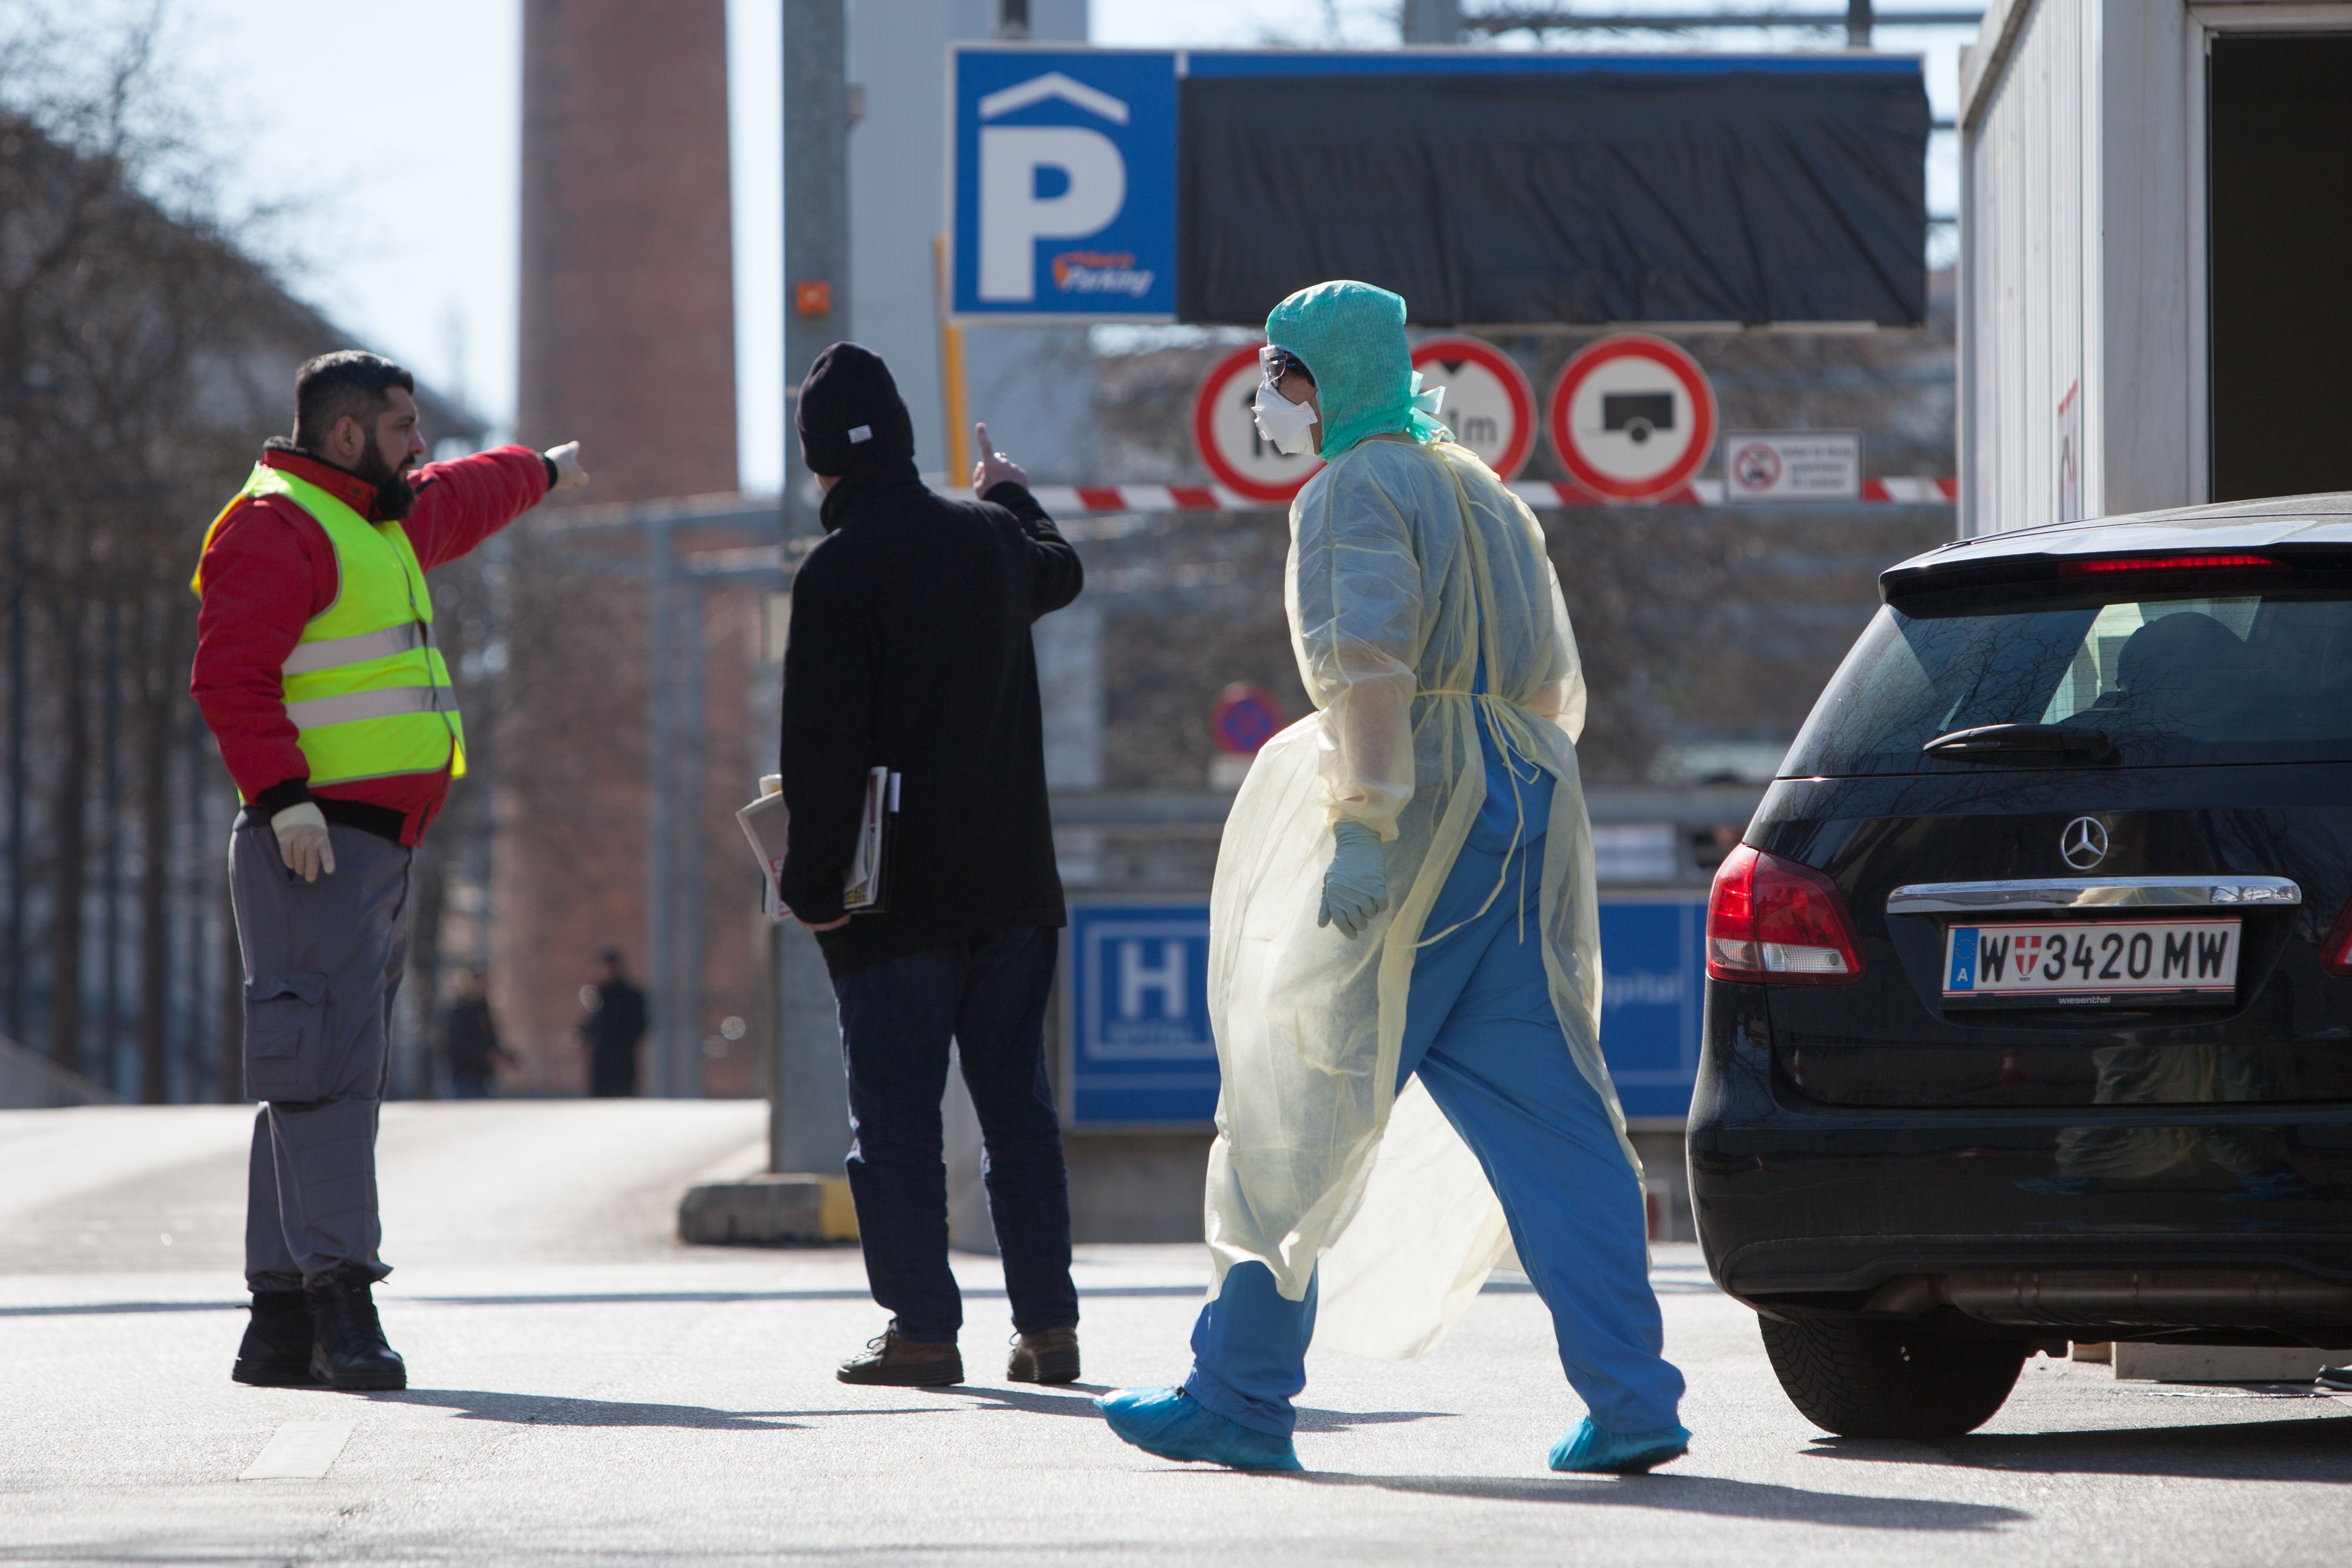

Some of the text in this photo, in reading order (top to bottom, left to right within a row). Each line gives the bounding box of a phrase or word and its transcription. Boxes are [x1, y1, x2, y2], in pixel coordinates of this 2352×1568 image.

[979, 126, 1125, 301] P
[1121, 942, 1187, 1018] H
[1956, 968, 1968, 981] A
[1980, 931, 2229, 982] W 3420 MW
